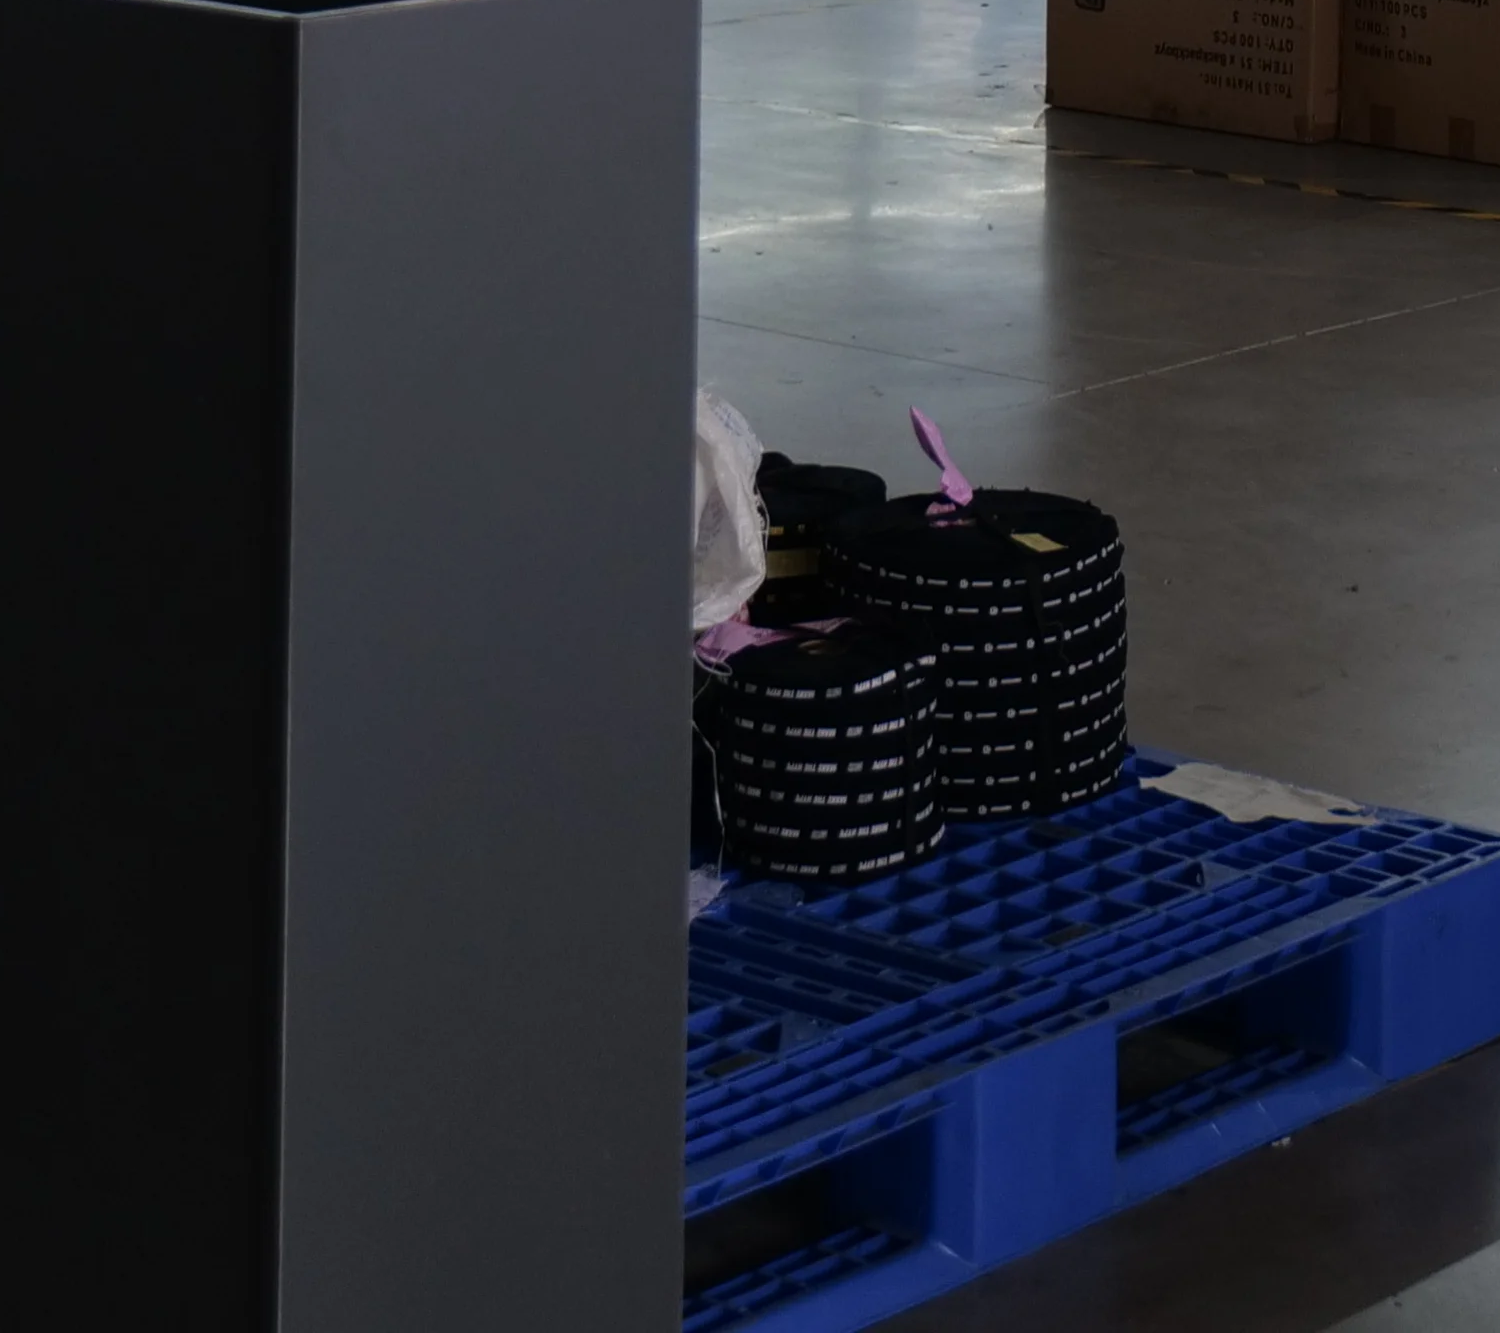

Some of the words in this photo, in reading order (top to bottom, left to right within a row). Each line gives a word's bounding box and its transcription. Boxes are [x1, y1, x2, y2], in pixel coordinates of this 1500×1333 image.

[1381, 0, 1400, 16] 100
[1403, 2, 1428, 20] PCS
[1213, 30, 1237, 47] PCS
[1240, 34, 1261, 50] 100
[1264, 37, 1294, 53] QTY:
[1154, 42, 1227, 68] Backpackboyz
[1355, 41, 1382, 59] Made
[1384, 44, 1395, 60] in
[1398, 49, 1433, 67] China
[1240, 58, 1253, 71] 31
[1257, 59, 1294, 75] ITEM:
[1199, 72, 1223, 89] Inc.
[1225, 76, 1254, 94] Hats
[1257, 81, 1272, 96] 31
[1274, 83, 1293, 99] To:
